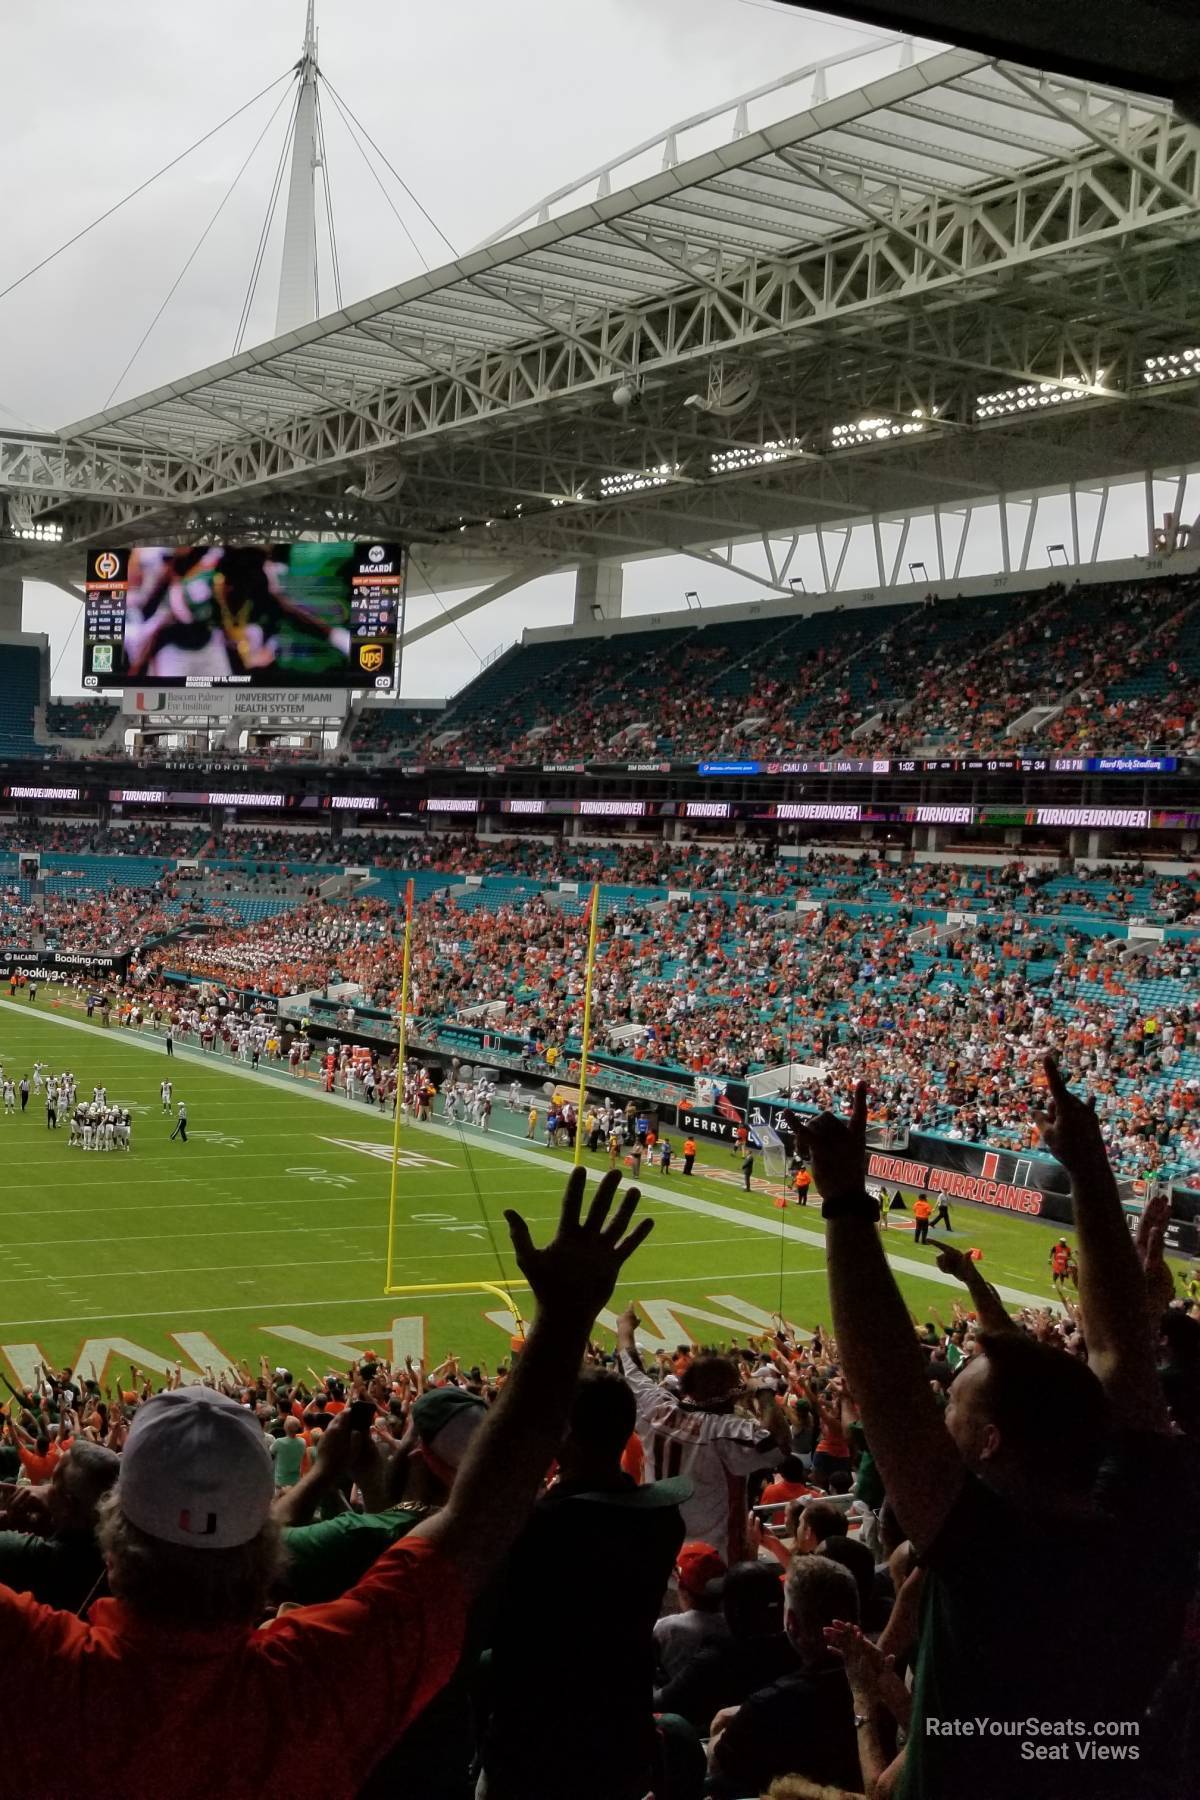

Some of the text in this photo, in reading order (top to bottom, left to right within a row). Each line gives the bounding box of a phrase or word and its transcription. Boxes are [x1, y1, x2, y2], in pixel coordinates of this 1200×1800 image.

[362, 651, 381, 667] ups
[85, 677, 97, 686] CC
[377, 678, 389, 687] CC
[235, 693, 332, 703] UNIVERSITY OF MIAMI
[235, 704, 305, 713] HEALTH SYSTEM
[782, 763, 800, 772] CMU
[802, 763, 808, 772] 0
[837, 763, 851, 772] MIA
[858, 763, 863, 772] 7
[898, 762, 915, 771] 1:02
[987, 761, 997, 770] 10
[1034, 761, 1045, 770] 34
[122, 790, 161, 802] TURNOVER
[332, 796, 375, 809] TURNOVER
[510, 800, 542, 812] TURNOVER
[686, 803, 727, 817] TURNOVER
[916, 807, 970, 823] TURNOVER
[55, 953, 112, 966] Booking.com
[685, 1115, 726, 1135] PERRY
[868, 1153, 927, 1188] MIAMI
[927, 1168, 1043, 1215] HURRICANES
